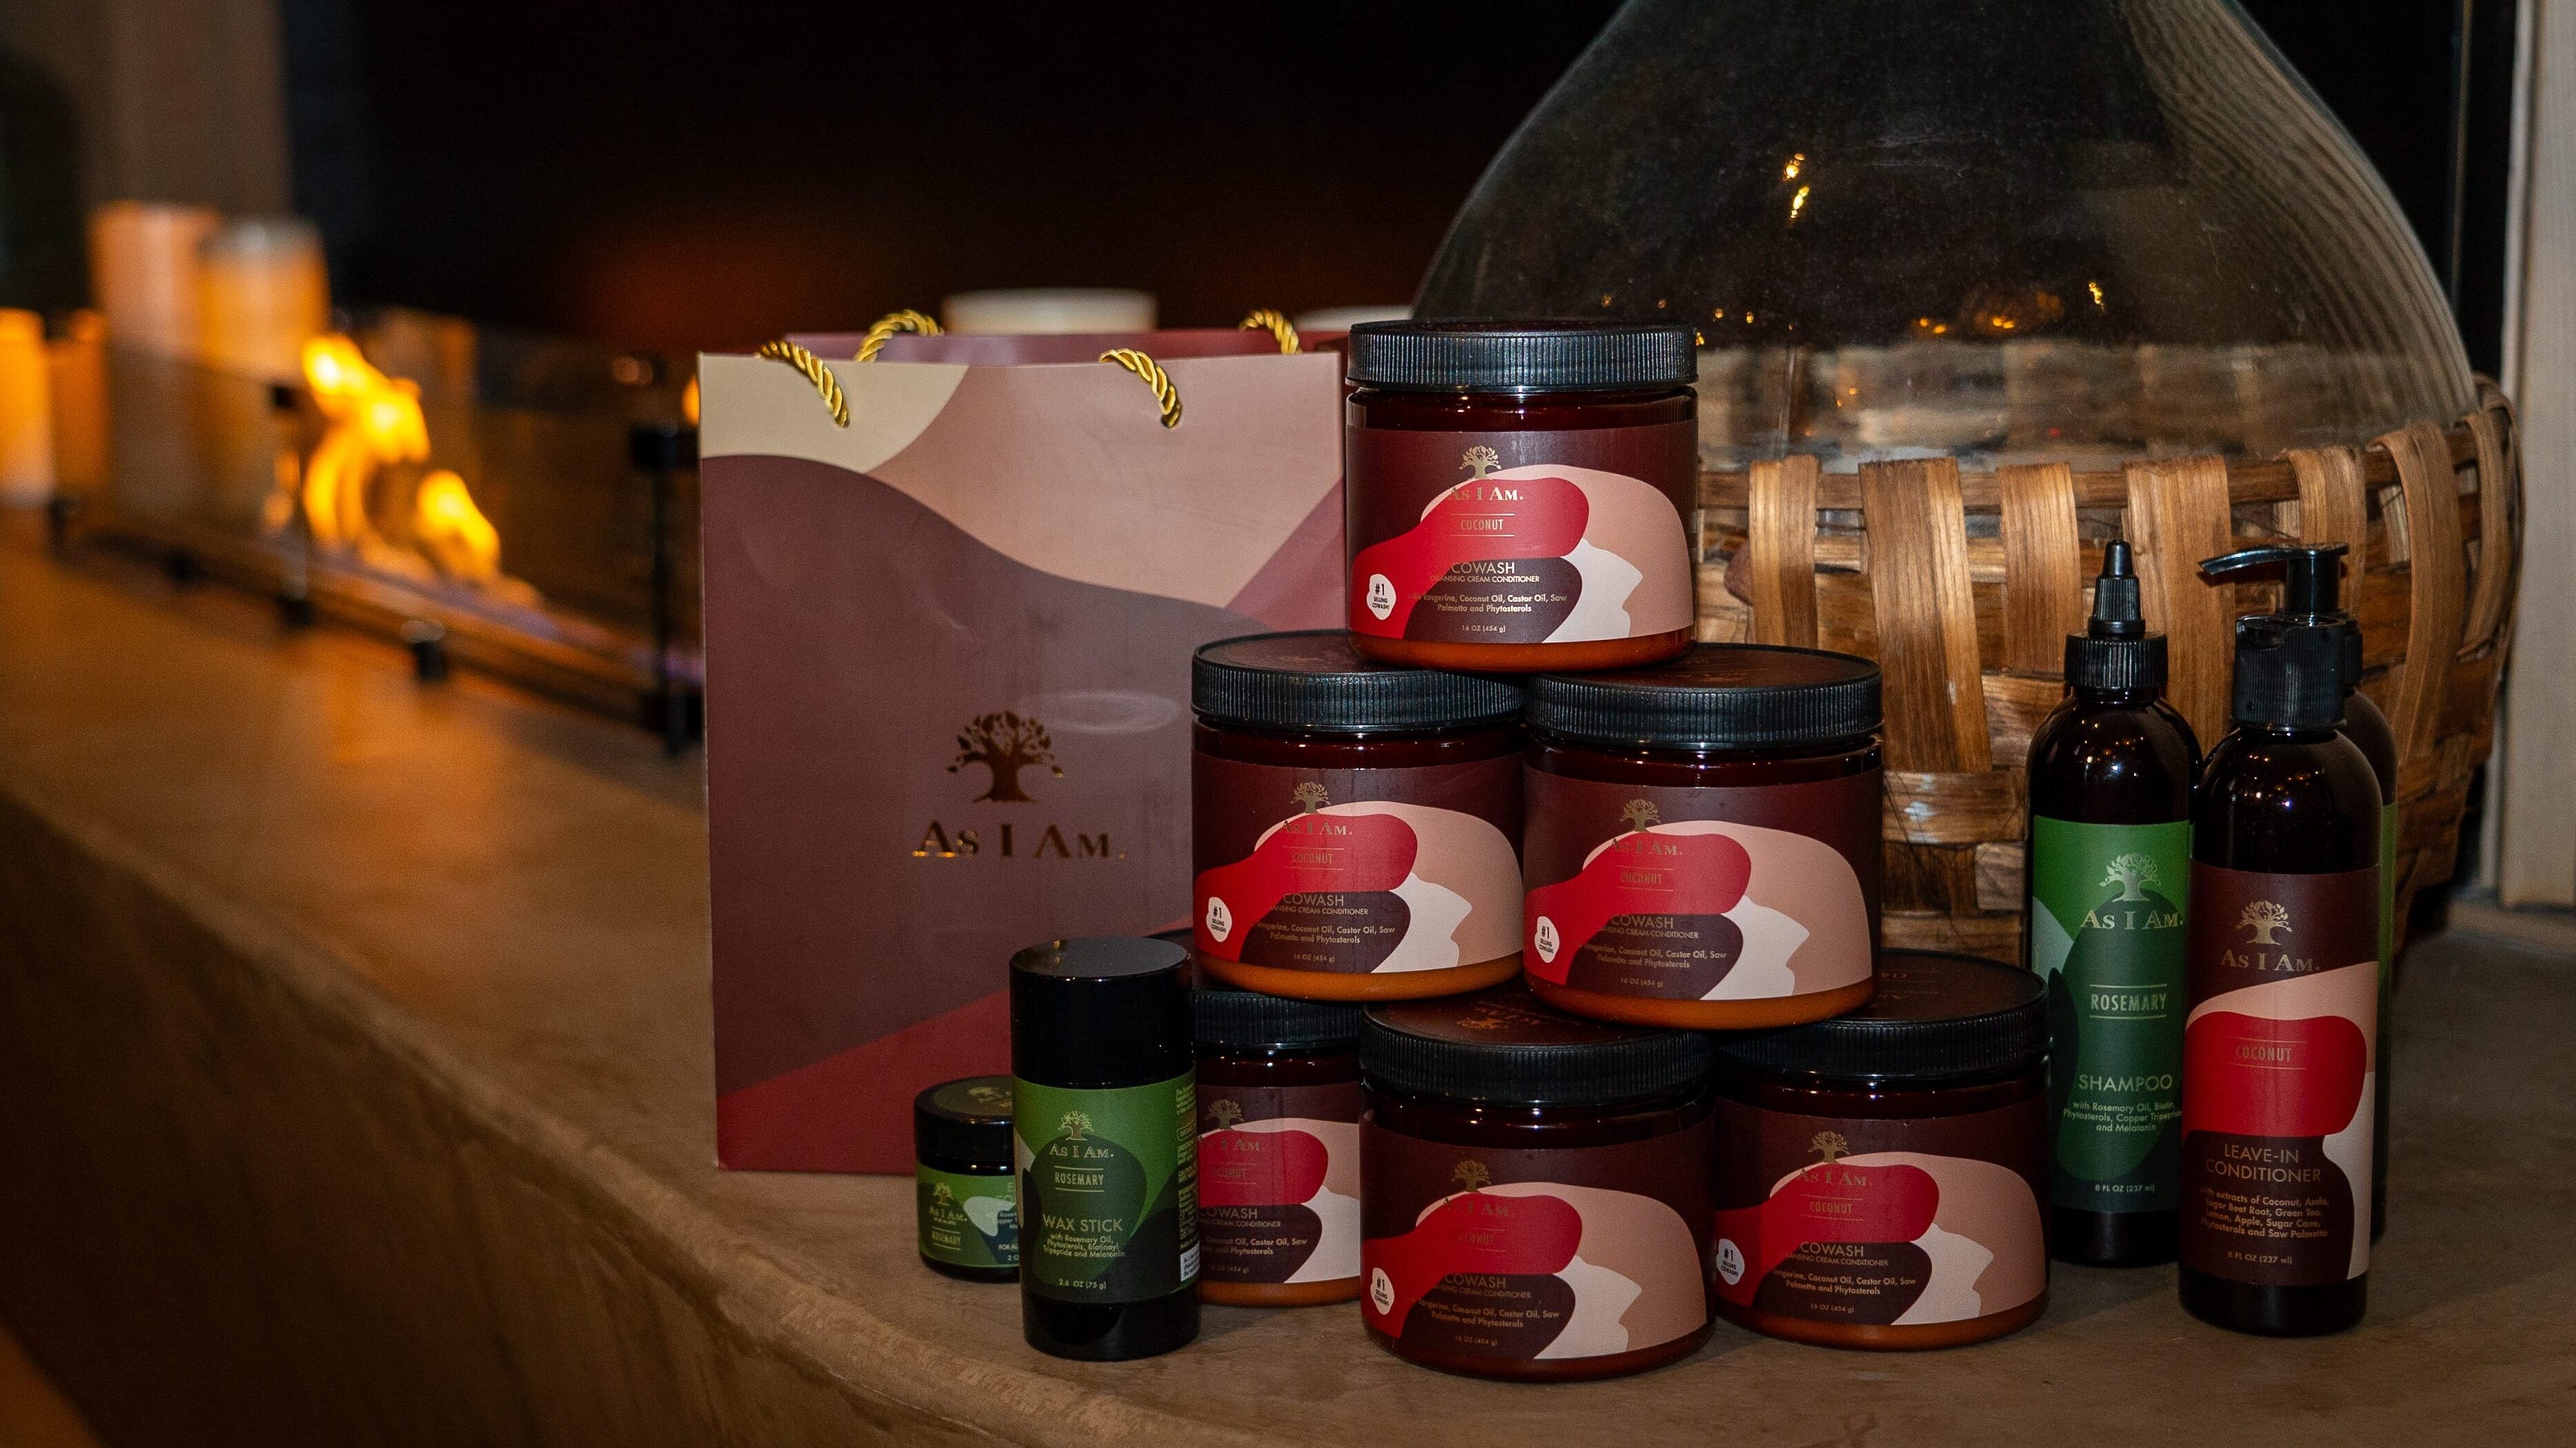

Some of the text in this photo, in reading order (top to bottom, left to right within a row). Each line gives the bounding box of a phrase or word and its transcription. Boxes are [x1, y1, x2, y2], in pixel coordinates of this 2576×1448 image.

[1447, 486, 1524, 501] As I Am.
[1460, 518, 1504, 530] COCONUT
[1451, 562, 1515, 574] COWASH
[1375, 583, 1385, 596] #1
[1459, 595, 1489, 603] Coconut
[1491, 594, 1505, 604] Oil,
[1507, 594, 1532, 603] Castor
[1534, 594, 1548, 603] Oil,
[1550, 593, 1567, 601] Saw
[1437, 604, 1532, 614] Palmetto and Phytosterols
[1482, 625, 1497, 633] (454
[1307, 821, 1315, 835] I
[1319, 821, 1353, 835] Am.
[911, 819, 1126, 860] As I Am.
[1648, 841, 1682, 856] Am.
[1283, 893, 1344, 906] COWASH
[1213, 906, 1222, 918] #1
[1322, 907, 1368, 915] CONDITIONER
[1612, 915, 1674, 929] COWASH
[2079, 909, 2184, 930] As I Am.
[1291, 924, 1319, 934] Coconut
[1321, 925, 1335, 934] Oil,
[1336, 926, 1361, 934] Castor
[1363, 926, 1377, 934] Oil,
[1541, 926, 1550, 939] #1
[1650, 930, 1699, 939] CONDITIONER
[1300, 934, 1315, 943] and
[1316, 934, 1360, 945] Phytosterols
[1649, 947, 1663, 958] Oil,
[1666, 950, 1691, 959] Castor
[1693, 950, 1707, 959] Oil,
[1710, 951, 1727, 959] Saw
[1628, 956, 1690, 969] and Phytosterols
[2221, 949, 2322, 972] As I Am.
[2091, 992, 2167, 1012] ROSEMARY
[2079, 1074, 2173, 1092] SHAMPOO
[2072, 1101, 2090, 1111] with
[2092, 1102, 2134, 1114] Rosemary
[2136, 1103, 2152, 1112] Oil,
[2062, 1108, 2149, 1124] Phytosterols, Copper
[2095, 1122, 2157, 1132] and Melatonin
[1049, 1143, 1114, 1158] As I Am.
[2224, 1143, 2299, 1164] LEAVE-IN
[2206, 1159, 2321, 1182] CONDITIONER
[1055, 1172, 1104, 1186] ROSEMARY
[2102, 1184, 2111, 1192] FL
[2126, 1185, 2143, 1194] (237
[2215, 1191, 2248, 1204] extracts
[2250, 1194, 2260, 1205] of
[2262, 1196, 2302, 1207] Coconut,
[1810, 1202, 1852, 1214] COCONUT
[2228, 1203, 2247, 1214] Beet
[2248, 1206, 2273, 1217] Root,
[2275, 1207, 2303, 1218] Green
[1042, 1213, 1124, 1232] WAX STICK
[2234, 1215, 2264, 1227] Apple,
[2265, 1218, 2294, 1230] Sugar
[2296, 1219, 2321, 1228] Cane,
[2248, 1227, 2265, 1237] and
[2267, 1228, 2289, 1238] Saw
[2290, 1229, 2329, 1239] Palmetto
[1064, 1234, 1114, 1246] Rosemary Oil,
[1235, 1238, 1248, 1246] Oil,
[1250, 1238, 1274, 1246] Castor
[1276, 1238, 1290, 1246] Oil,
[1292, 1237, 1307, 1245] Saw
[1088, 1242, 1119, 1252] Biotinoyl
[1230, 1247, 1274, 1256] Phytosterols
[1800, 1242, 1864, 1256] COWASH
[1089, 1250, 1125, 1258] Melatonin
[1724, 1248, 1733, 1261] #1
[2244, 1253, 2257, 1262] OZ
[2259, 1255, 2278, 1264] (237
[2280, 1256, 2293, 1264] ml)
[1815, 1256, 1889, 1266] CREAM CONDITIONER
[1059, 1278, 1107, 1290] 2.6 OZ (75 g)
[1377, 1277, 1385, 1291] #1
[1445, 1274, 1505, 1288] COWASH
[1808, 1273, 1838, 1283] Coconut
[1839, 1276, 1854, 1285] Oil,
[1856, 1277, 1880, 1285] Castor
[1884, 1277, 1897, 1286] Oil,
[1785, 1280, 1880, 1296] Palmetto and Phytosterols
[1452, 1304, 1560, 1319] Coconut Oil, Castor Oil, Saw
[1462, 1316, 1476, 1326] and
[1478, 1317, 1524, 1329] Phytosterols
